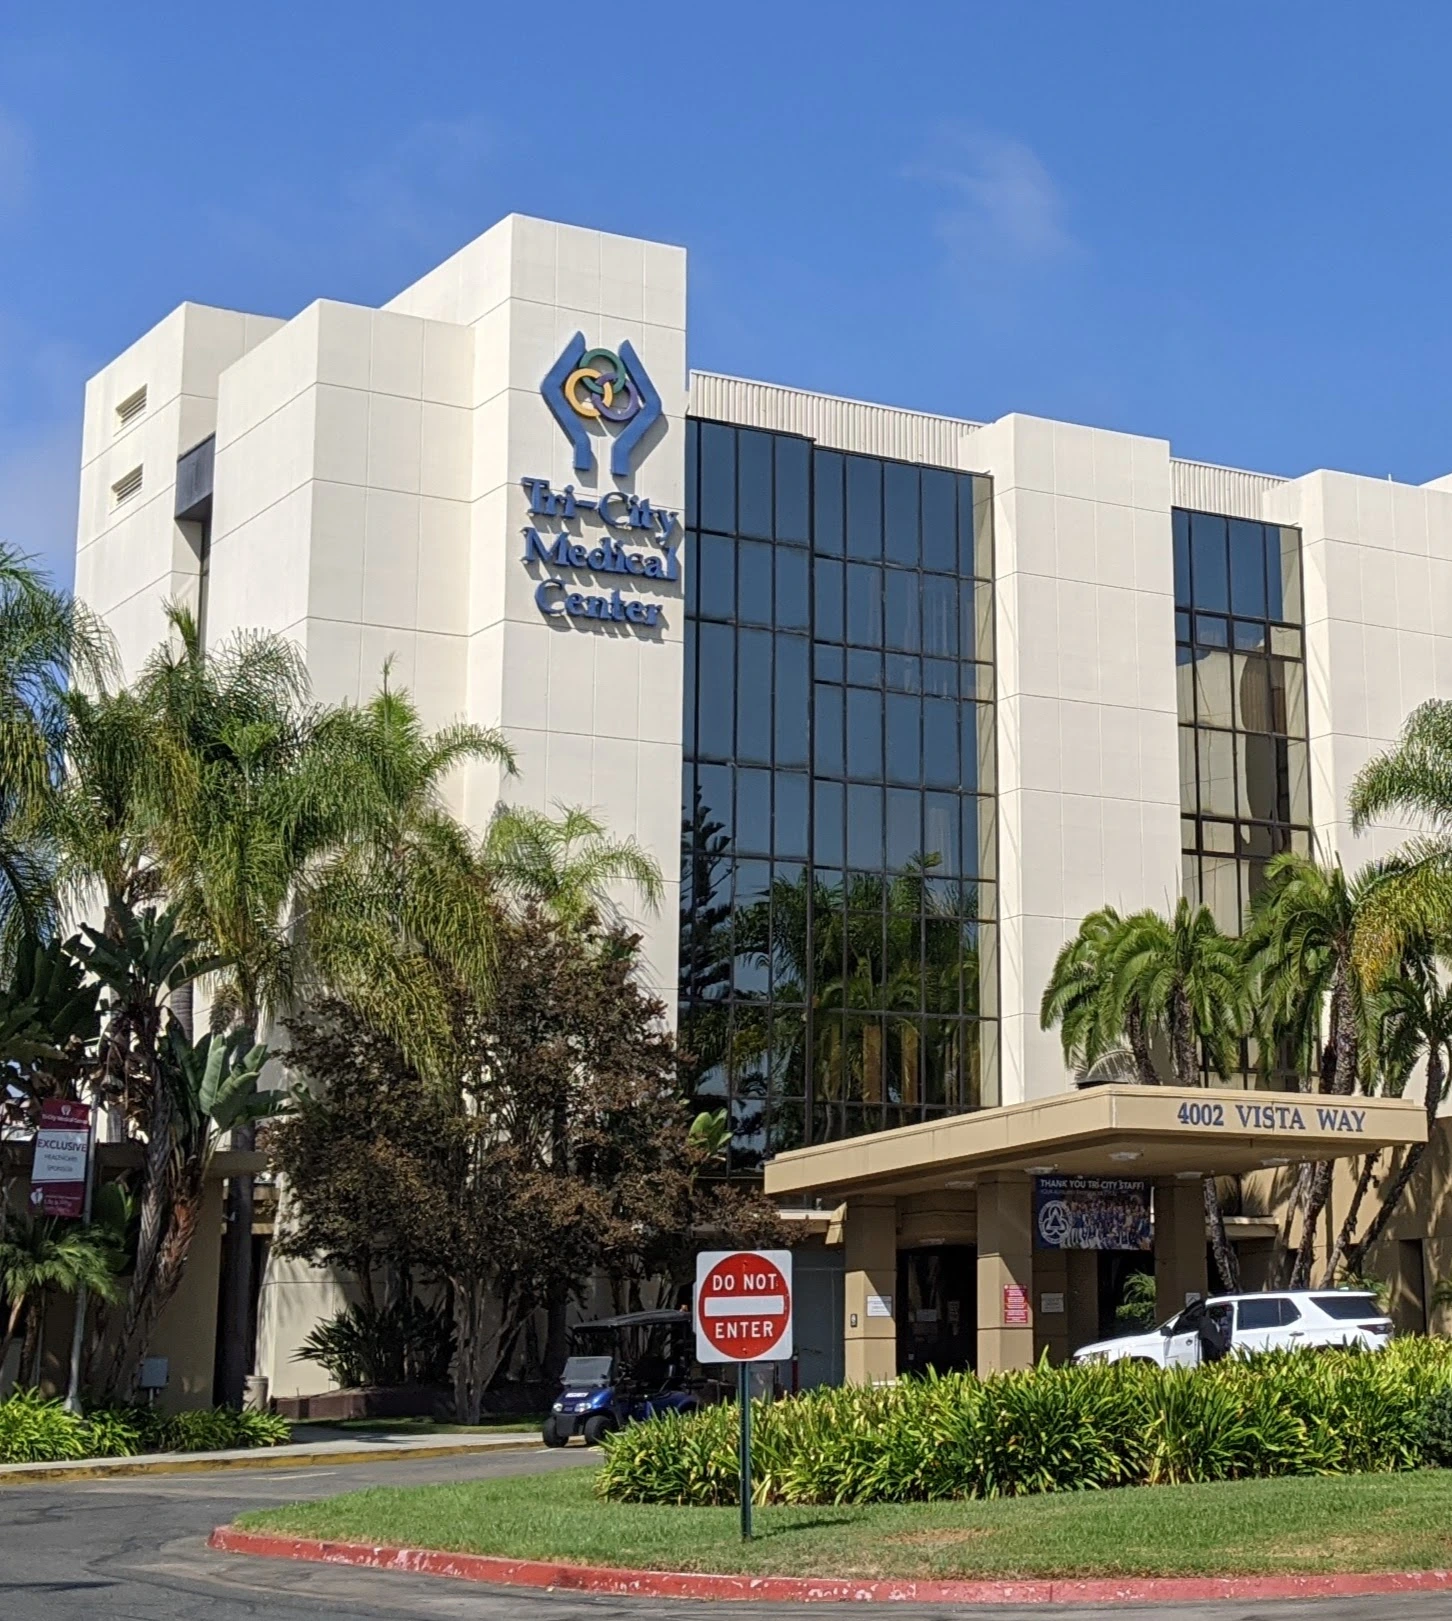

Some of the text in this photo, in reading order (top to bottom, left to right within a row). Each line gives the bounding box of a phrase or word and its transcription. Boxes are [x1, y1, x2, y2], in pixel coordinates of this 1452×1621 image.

[521, 476, 679, 546] Tri-City
[520, 526, 679, 581] Medical
[534, 578, 664, 627] Center
[1177, 1101, 1366, 1133] 4002 VISTA WAY
[37, 1139, 87, 1152] EXCLUSIVE
[1040, 1179, 1067, 1188] THANK
[1069, 1180, 1086, 1189] YOU
[713, 1273, 777, 1291] DO NOT
[715, 1321, 773, 1339] ENTER
